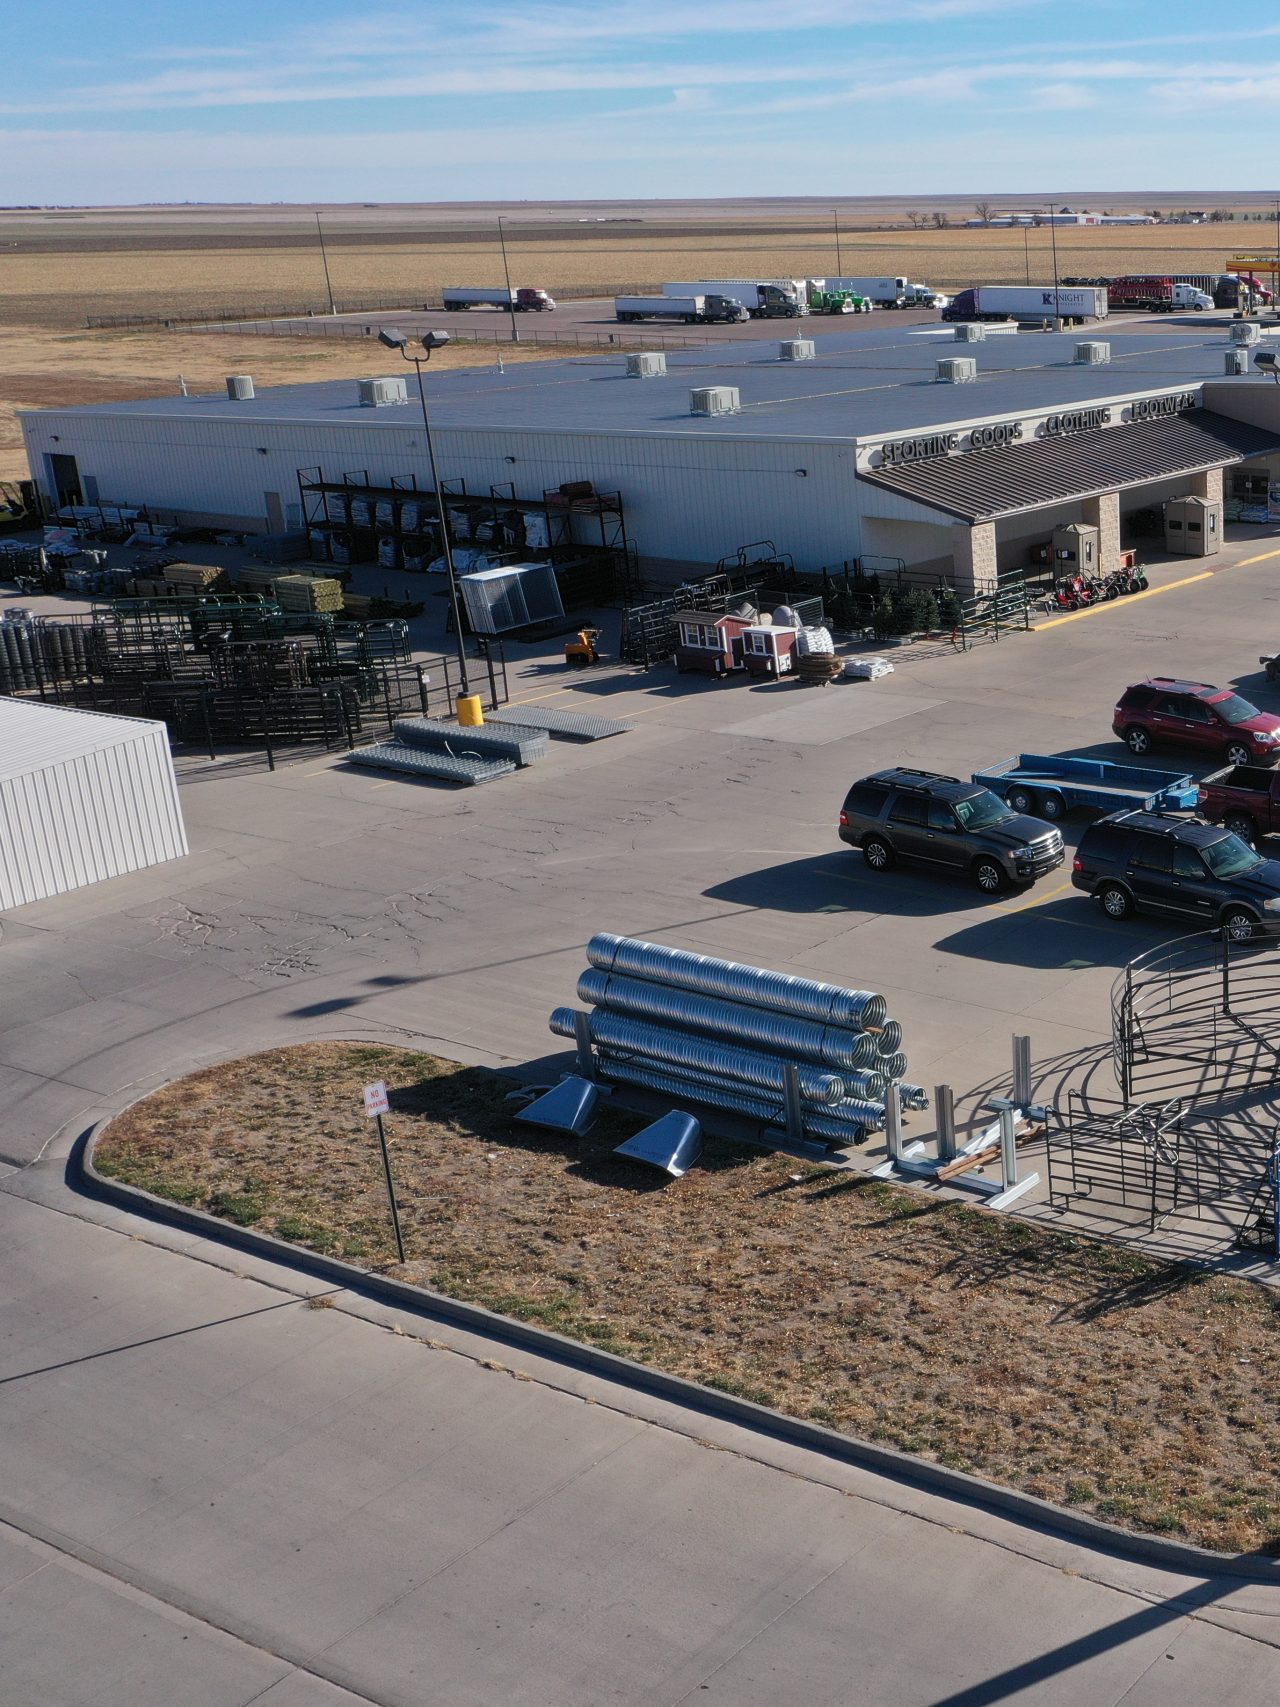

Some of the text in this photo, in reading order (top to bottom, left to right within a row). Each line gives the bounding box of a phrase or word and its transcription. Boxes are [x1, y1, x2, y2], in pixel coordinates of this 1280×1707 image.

[882, 392, 1196, 464] SPORTING GOODS CLOTHING FOOTWEAR
[370, 1090, 379, 1099] NO
